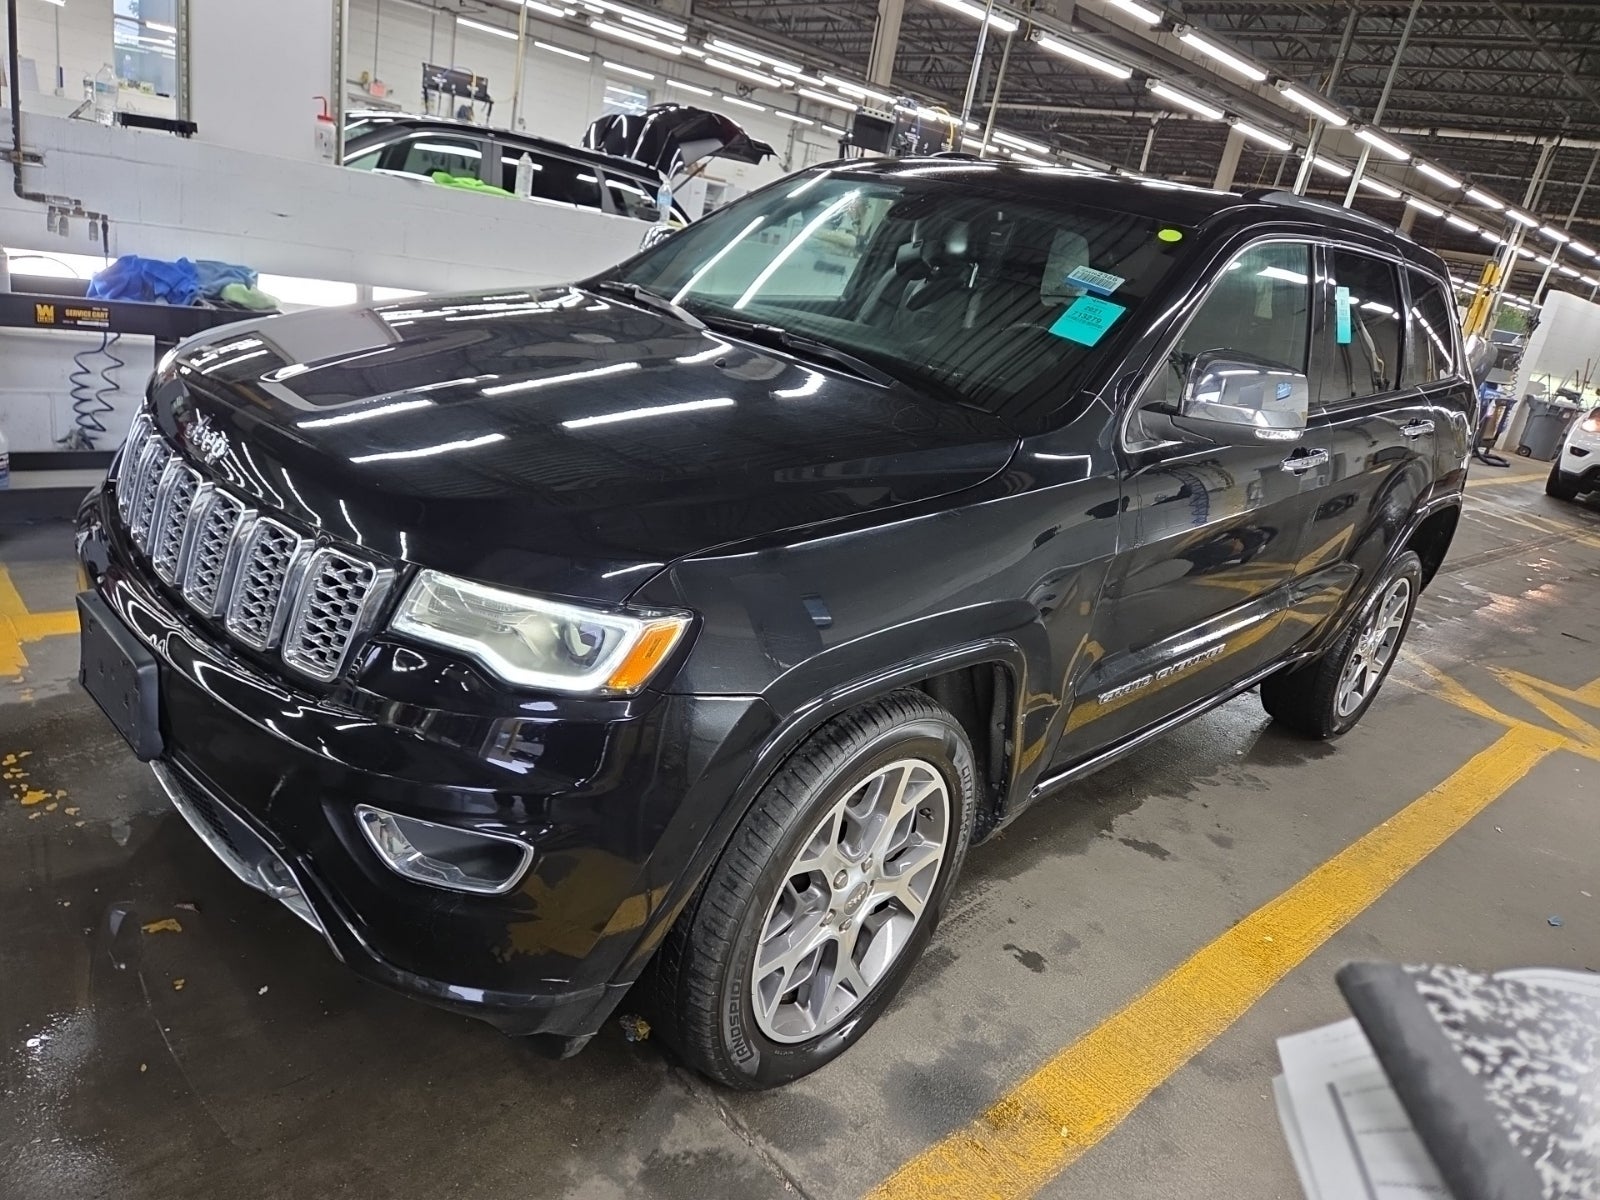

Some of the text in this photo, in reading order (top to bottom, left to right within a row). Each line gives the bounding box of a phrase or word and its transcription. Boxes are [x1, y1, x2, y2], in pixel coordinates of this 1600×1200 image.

[65, 308, 91, 318] SERVICE
[92, 310, 109, 319] CART
[184, 421, 229, 464] Jeep
[1098, 643, 1227, 705] GRAND CHEROKEE
